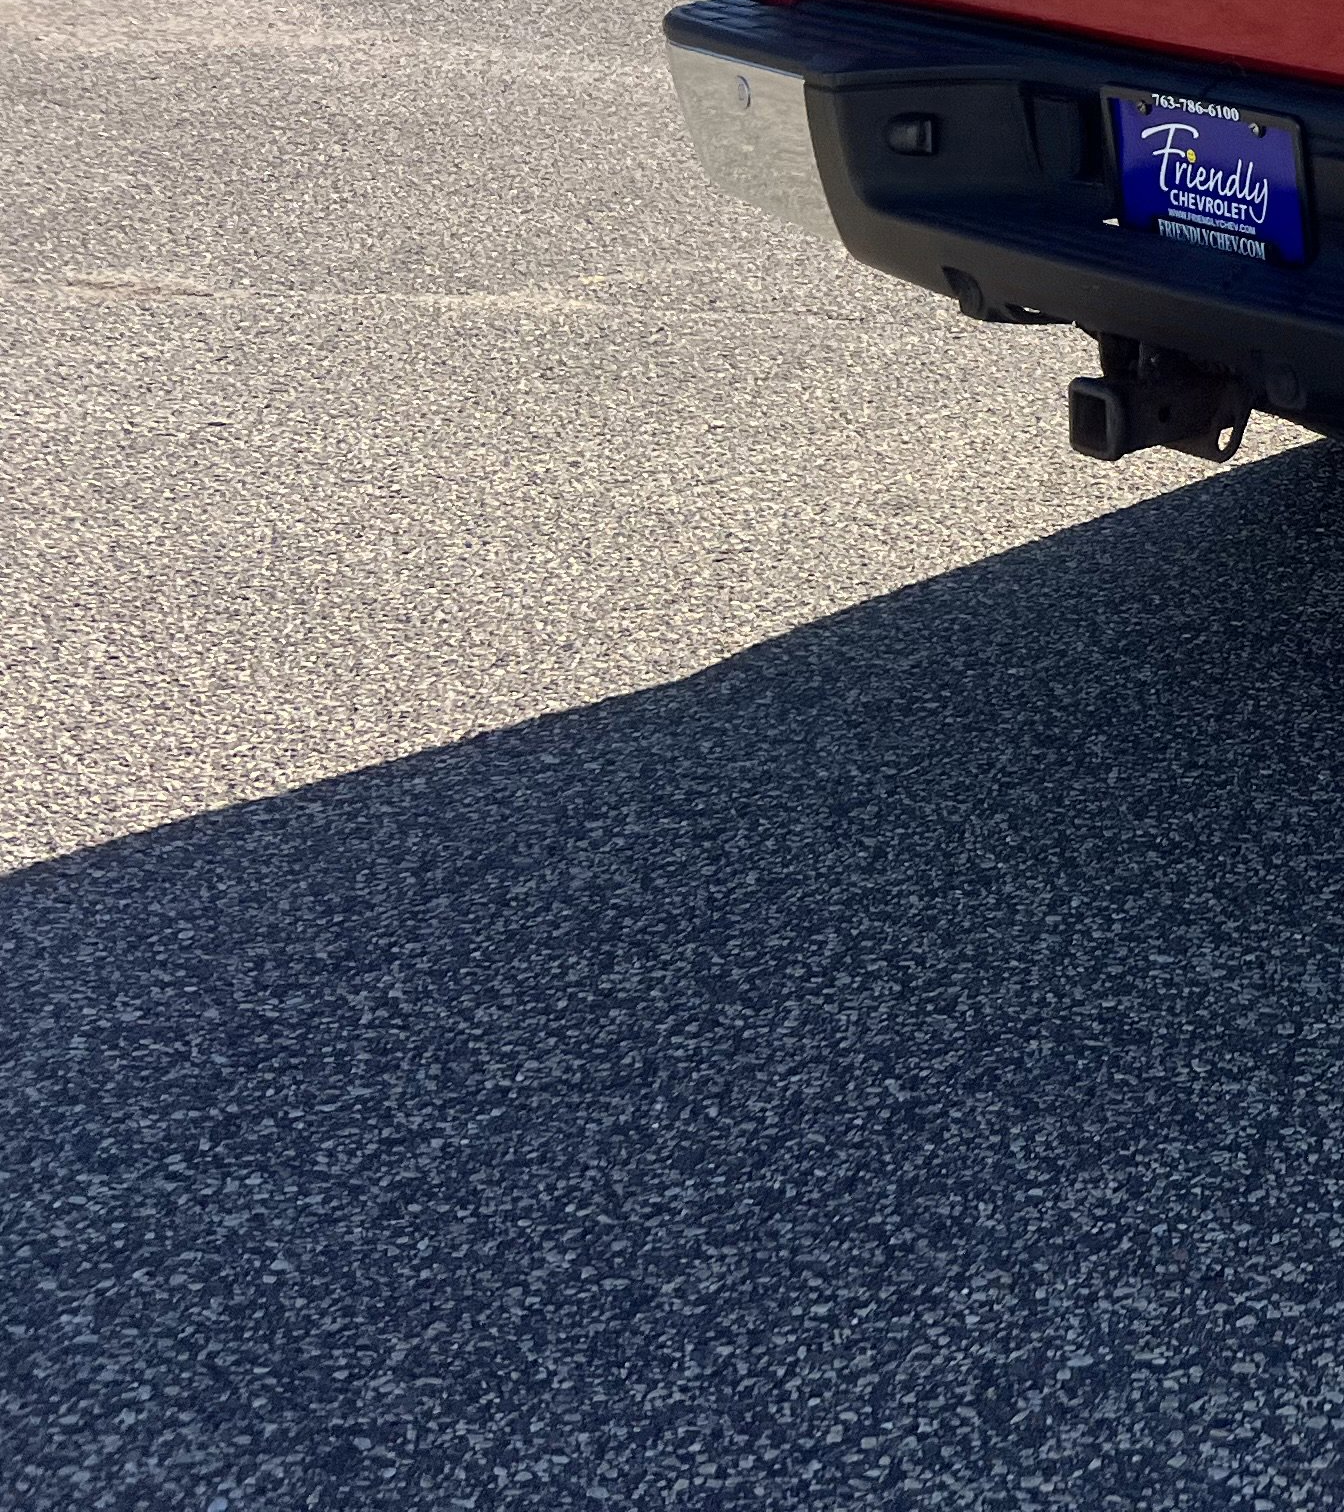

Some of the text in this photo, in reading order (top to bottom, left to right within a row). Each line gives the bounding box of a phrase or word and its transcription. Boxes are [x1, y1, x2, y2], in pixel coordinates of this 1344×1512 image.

[1151, 93, 1240, 121] 763-786-6100
[1141, 123, 1268, 223] Friendly
[1169, 189, 1248, 220] CHEVROLET
[1157, 218, 1267, 261] FRIENDLYCHEV.COM
